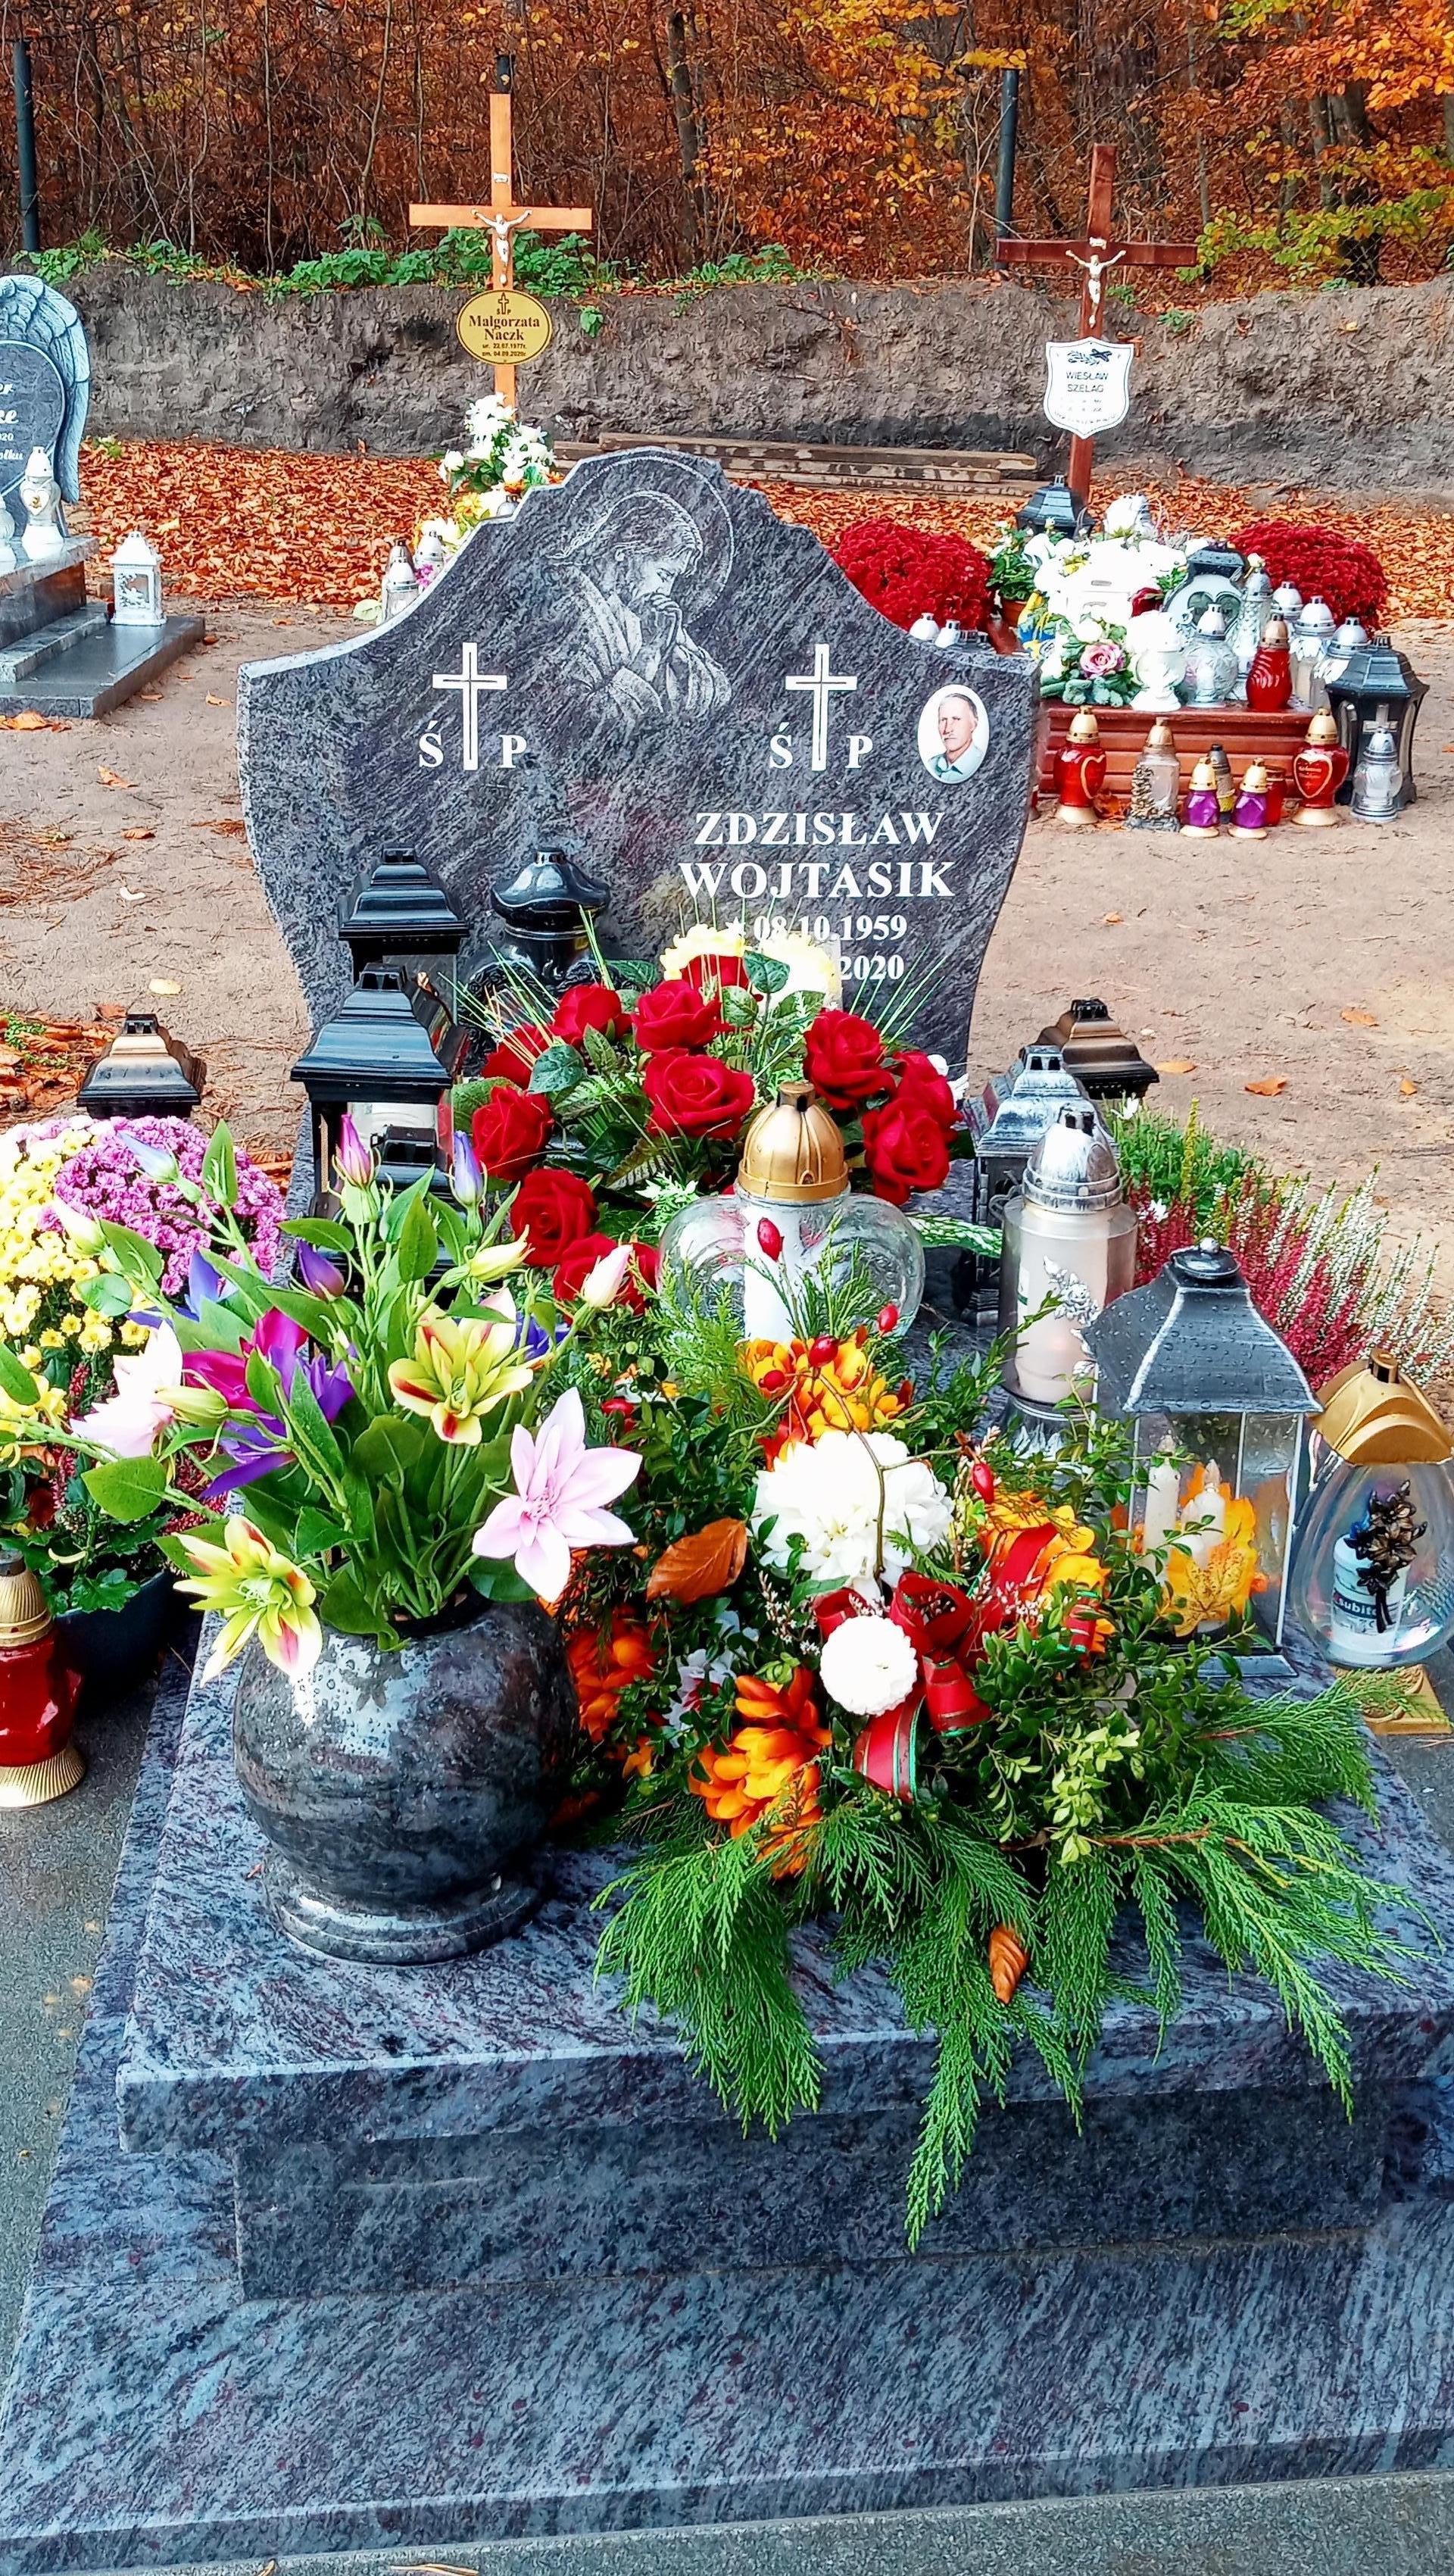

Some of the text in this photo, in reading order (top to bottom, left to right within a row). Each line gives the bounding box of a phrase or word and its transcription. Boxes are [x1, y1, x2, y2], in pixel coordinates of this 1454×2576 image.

[418, 720, 528, 769] Ś P
[769, 721, 874, 770] Ś P
[693, 812, 946, 846] ZDZISŁAW
[678, 860, 956, 899] WOJTASIK
[753, 914, 908, 941] 0810.1959
